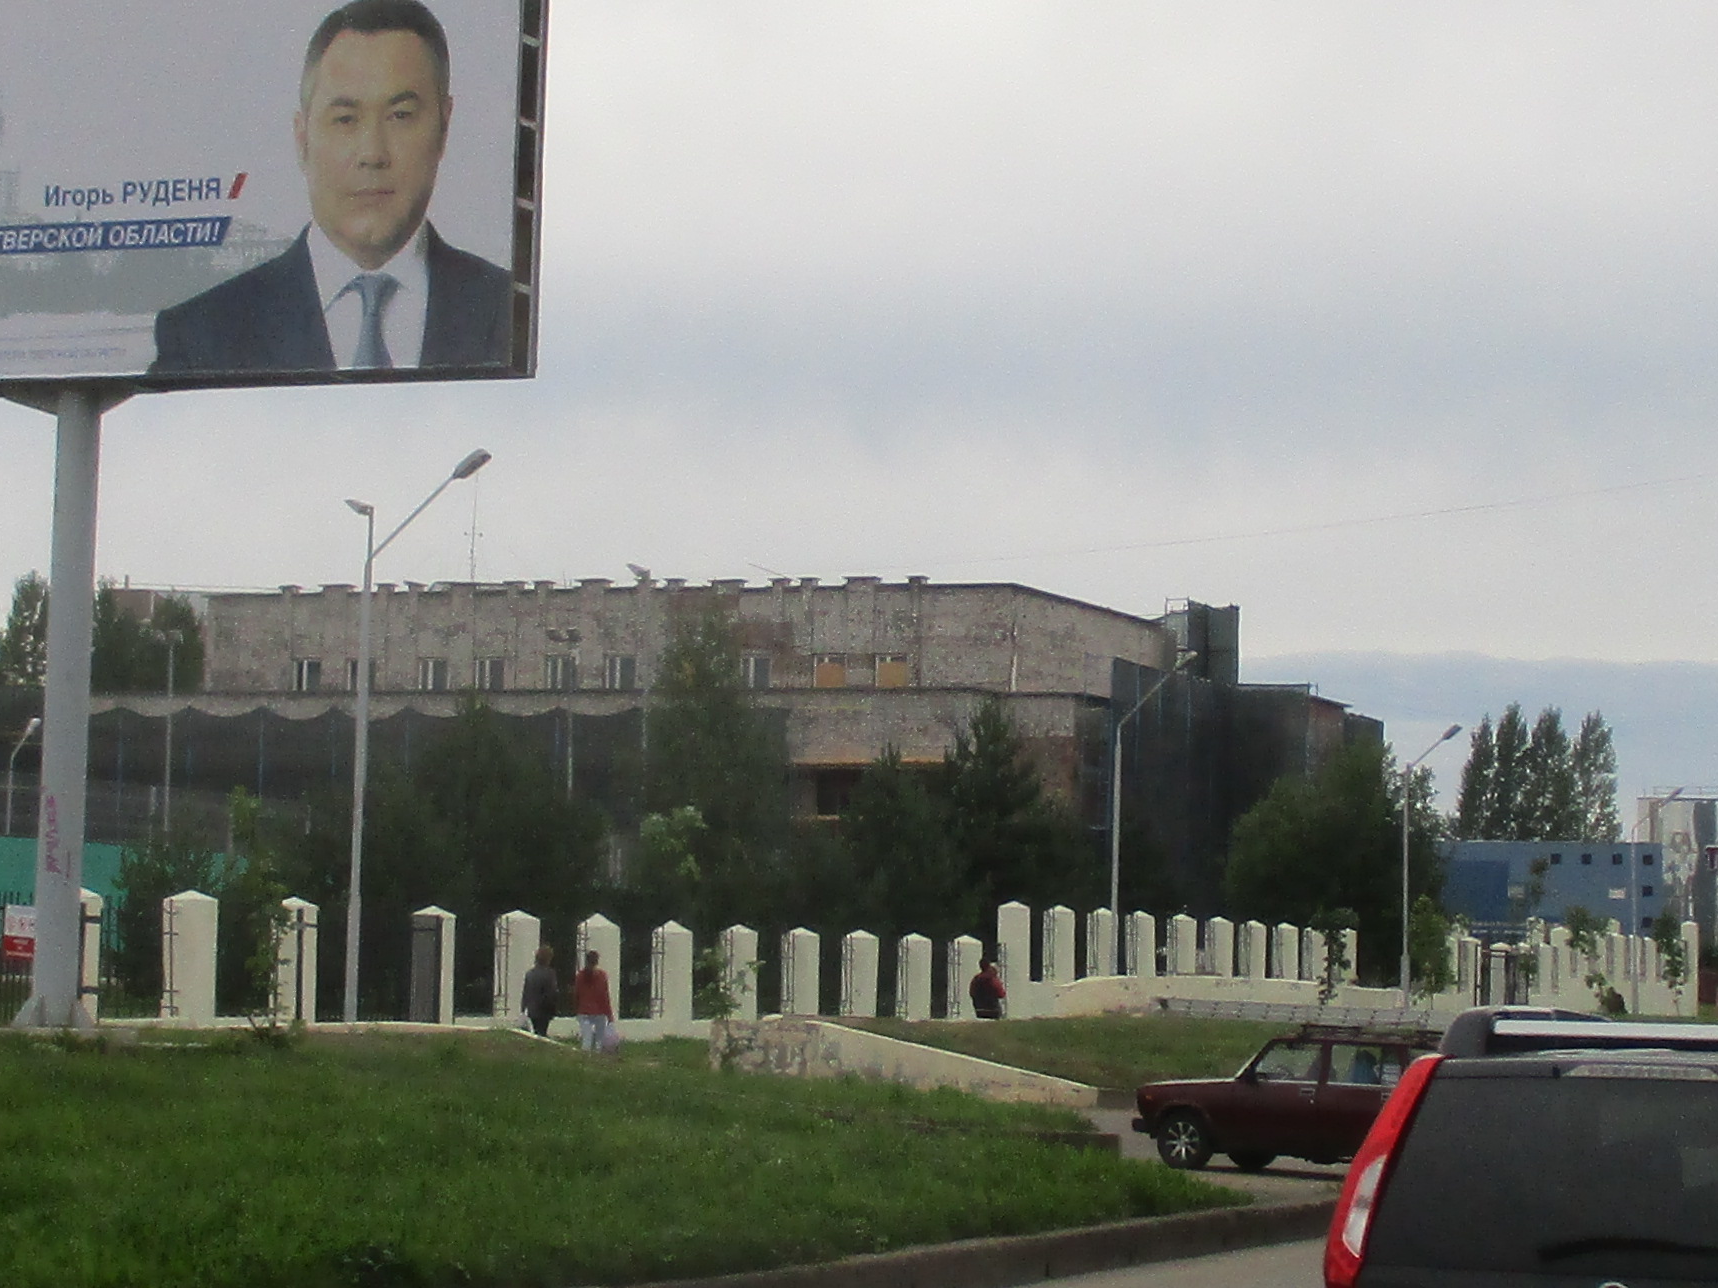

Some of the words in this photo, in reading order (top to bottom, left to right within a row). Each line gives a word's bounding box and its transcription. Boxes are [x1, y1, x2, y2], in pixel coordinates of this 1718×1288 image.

[44, 185, 114, 211] Игорь
[121, 178, 221, 207] РУДЕНЯ
[108, 221, 220, 247] ОБЛАСТИ!
